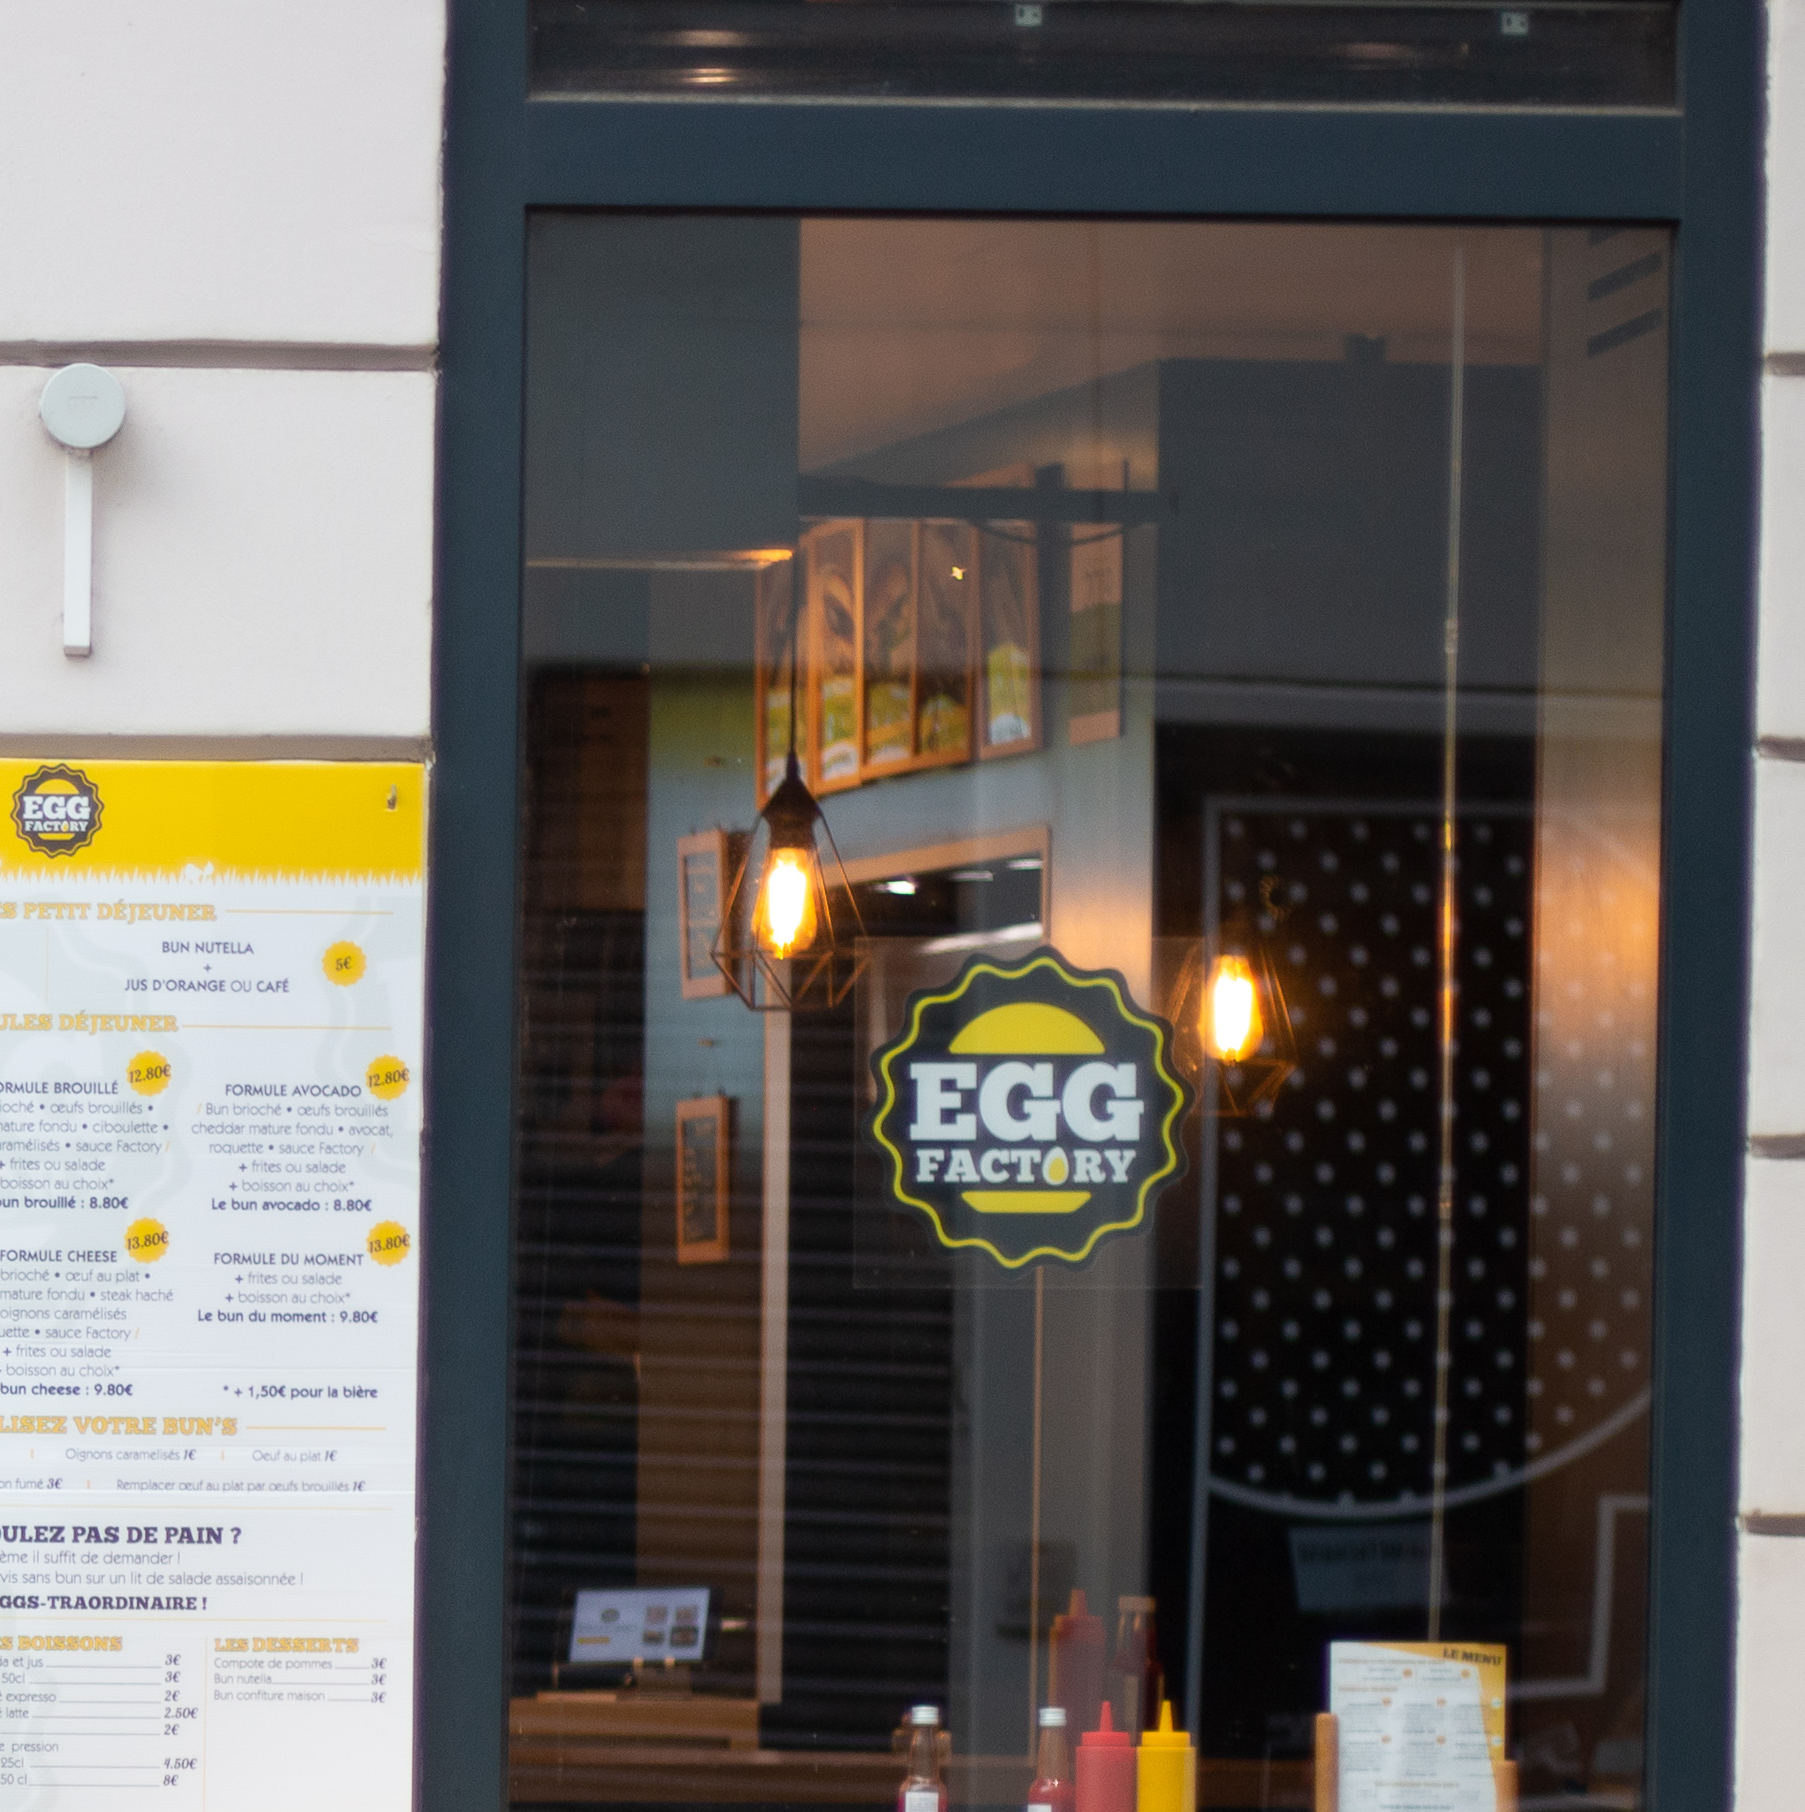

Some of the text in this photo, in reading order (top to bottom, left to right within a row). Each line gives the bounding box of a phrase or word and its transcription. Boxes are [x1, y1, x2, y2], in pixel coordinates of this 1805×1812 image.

[22, 796, 91, 820] EGG
[23, 903, 91, 920] PETIT
[96, 899, 217, 924] DÉJEUNER
[163, 942, 254, 954] BUN NUTELLA
[335, 956, 352, 971] 5€
[59, 1010, 179, 1035] DÉJEUNER
[129, 1064, 172, 1084] 12.80€
[368, 1068, 410, 1088] 12.80€
[54, 1079, 118, 1094] BROUILLÉ
[226, 1084, 362, 1097] FORMULE AVOCADO
[909, 1061, 1145, 1142] EGG
[127, 1232, 170, 1250] 13.80€
[368, 1234, 411, 1253] 13.80€
[0, 1250, 117, 1263] FORMULE CHEESE
[214, 1253, 364, 1266] FORMULE DU MOMENT
[73, 1416, 157, 1435] VOTRE
[162, 1417, 238, 1436] BUN'S
[73, 1527, 119, 1543] PAS
[127, 1527, 158, 1543] DE
[165, 1527, 223, 1544] PAIN
[231, 1527, 242, 1544] ?
[18, 1636, 123, 1651] BOISSONS
[214, 1637, 359, 1653] LES DESSERTS
[1443, 1649, 1502, 1666] LE MENU
